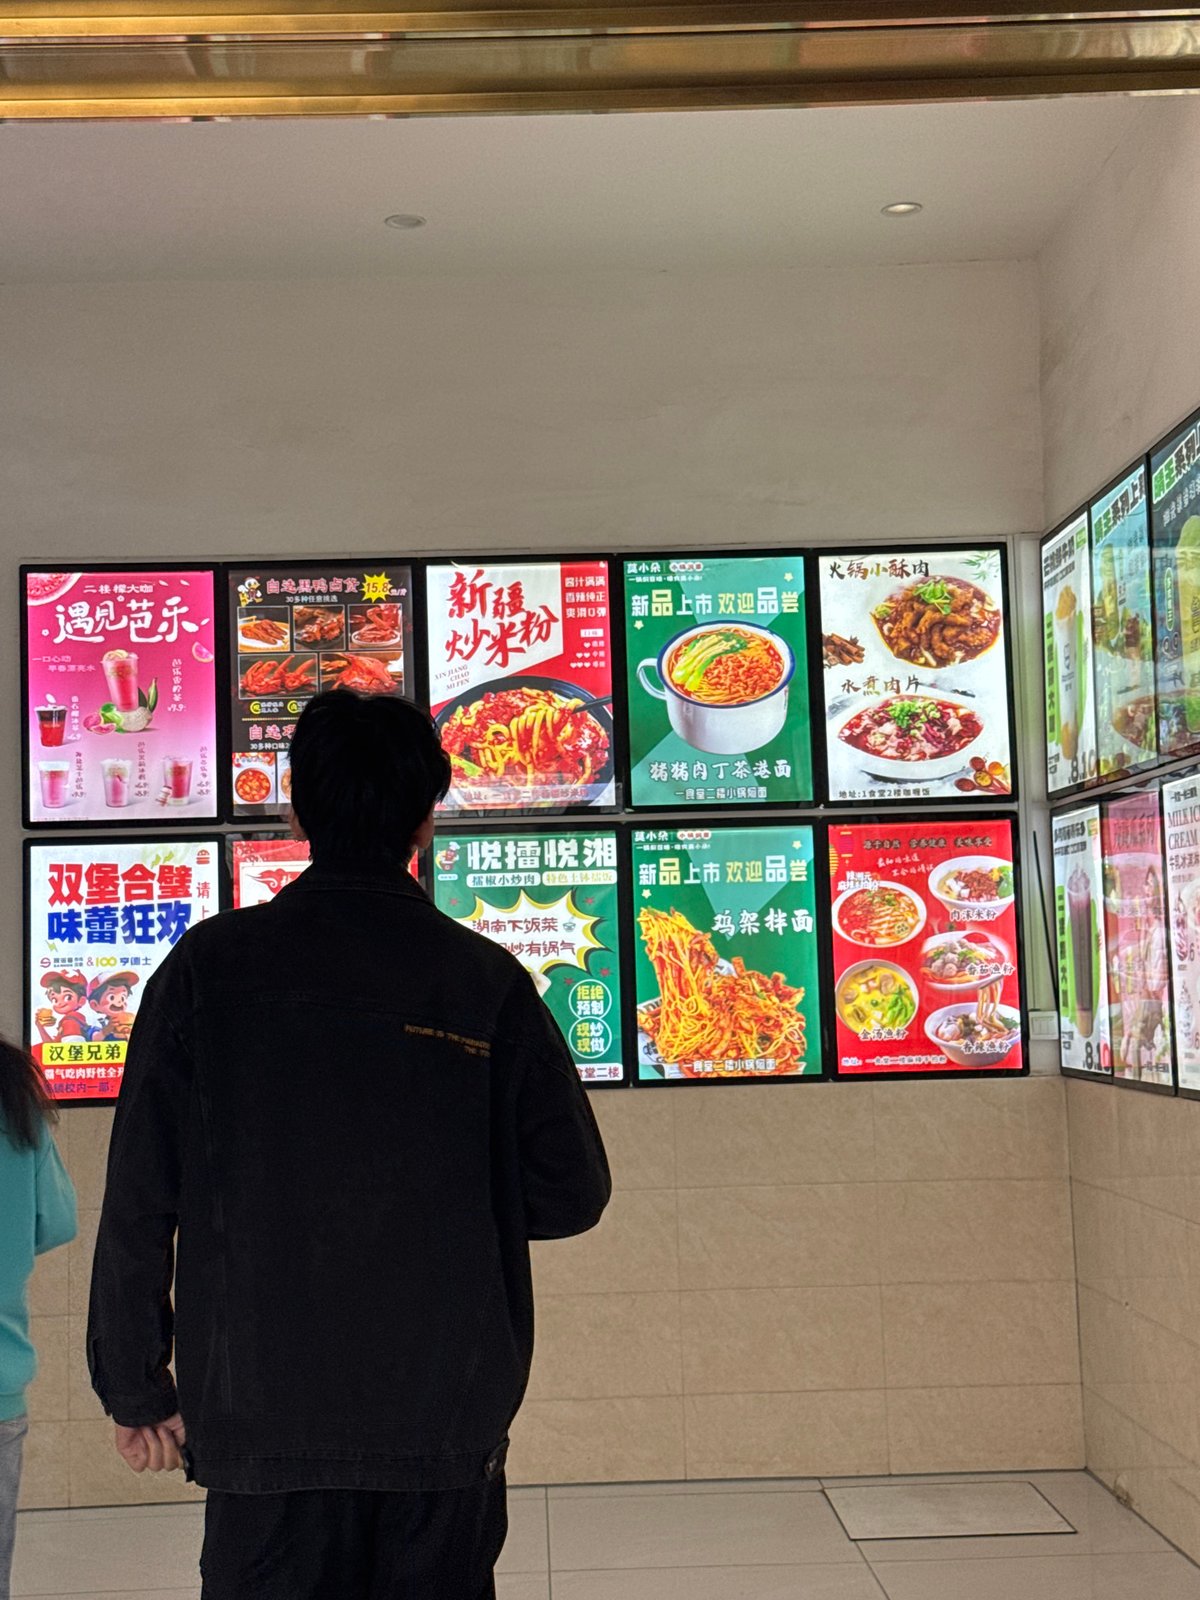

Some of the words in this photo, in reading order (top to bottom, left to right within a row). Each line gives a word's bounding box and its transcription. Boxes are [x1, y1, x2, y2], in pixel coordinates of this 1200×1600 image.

[829, 559, 929, 580] 火锅小酥肉
[266, 577, 360, 594] 自选黑鸭卤货
[366, 582, 388, 593] 15.8
[446, 569, 527, 619] 新疆
[565, 591, 606, 603] 香辣纯正
[631, 589, 712, 617] 新品上市
[718, 586, 799, 615] 欢迎品尝
[53, 596, 200, 644] 遇见芭乐
[445, 605, 560, 668] 炒米粉
[447, 664, 468, 677] JIANG
[450, 671, 470, 682] CHAO
[841, 675, 920, 696] 水煮肉片
[1168, 807, 1188, 829] MILK
[1168, 829, 1198, 850] CREAM
[467, 838, 618, 871] 悦擂悦湘
[639, 857, 720, 886] 新品上市
[726, 854, 808, 883] 欢迎品尝
[48, 863, 193, 907] 双堡合璧
[48, 900, 192, 945] 味蕾狂欢
[472, 917, 558, 934] 湖南下饭菜
[711, 908, 814, 936] 鸡架拌面
[950, 908, 997, 922] 肉沫米粉
[502, 940, 576, 957] 炒有锅气
[577, 985, 604, 1000] 拒绝
[577, 1000, 604, 1015] 预制
[576, 1022, 604, 1036] 现炒
[49, 1044, 121, 1061] 汉堡兄弟
[577, 1038, 604, 1052] 现做
